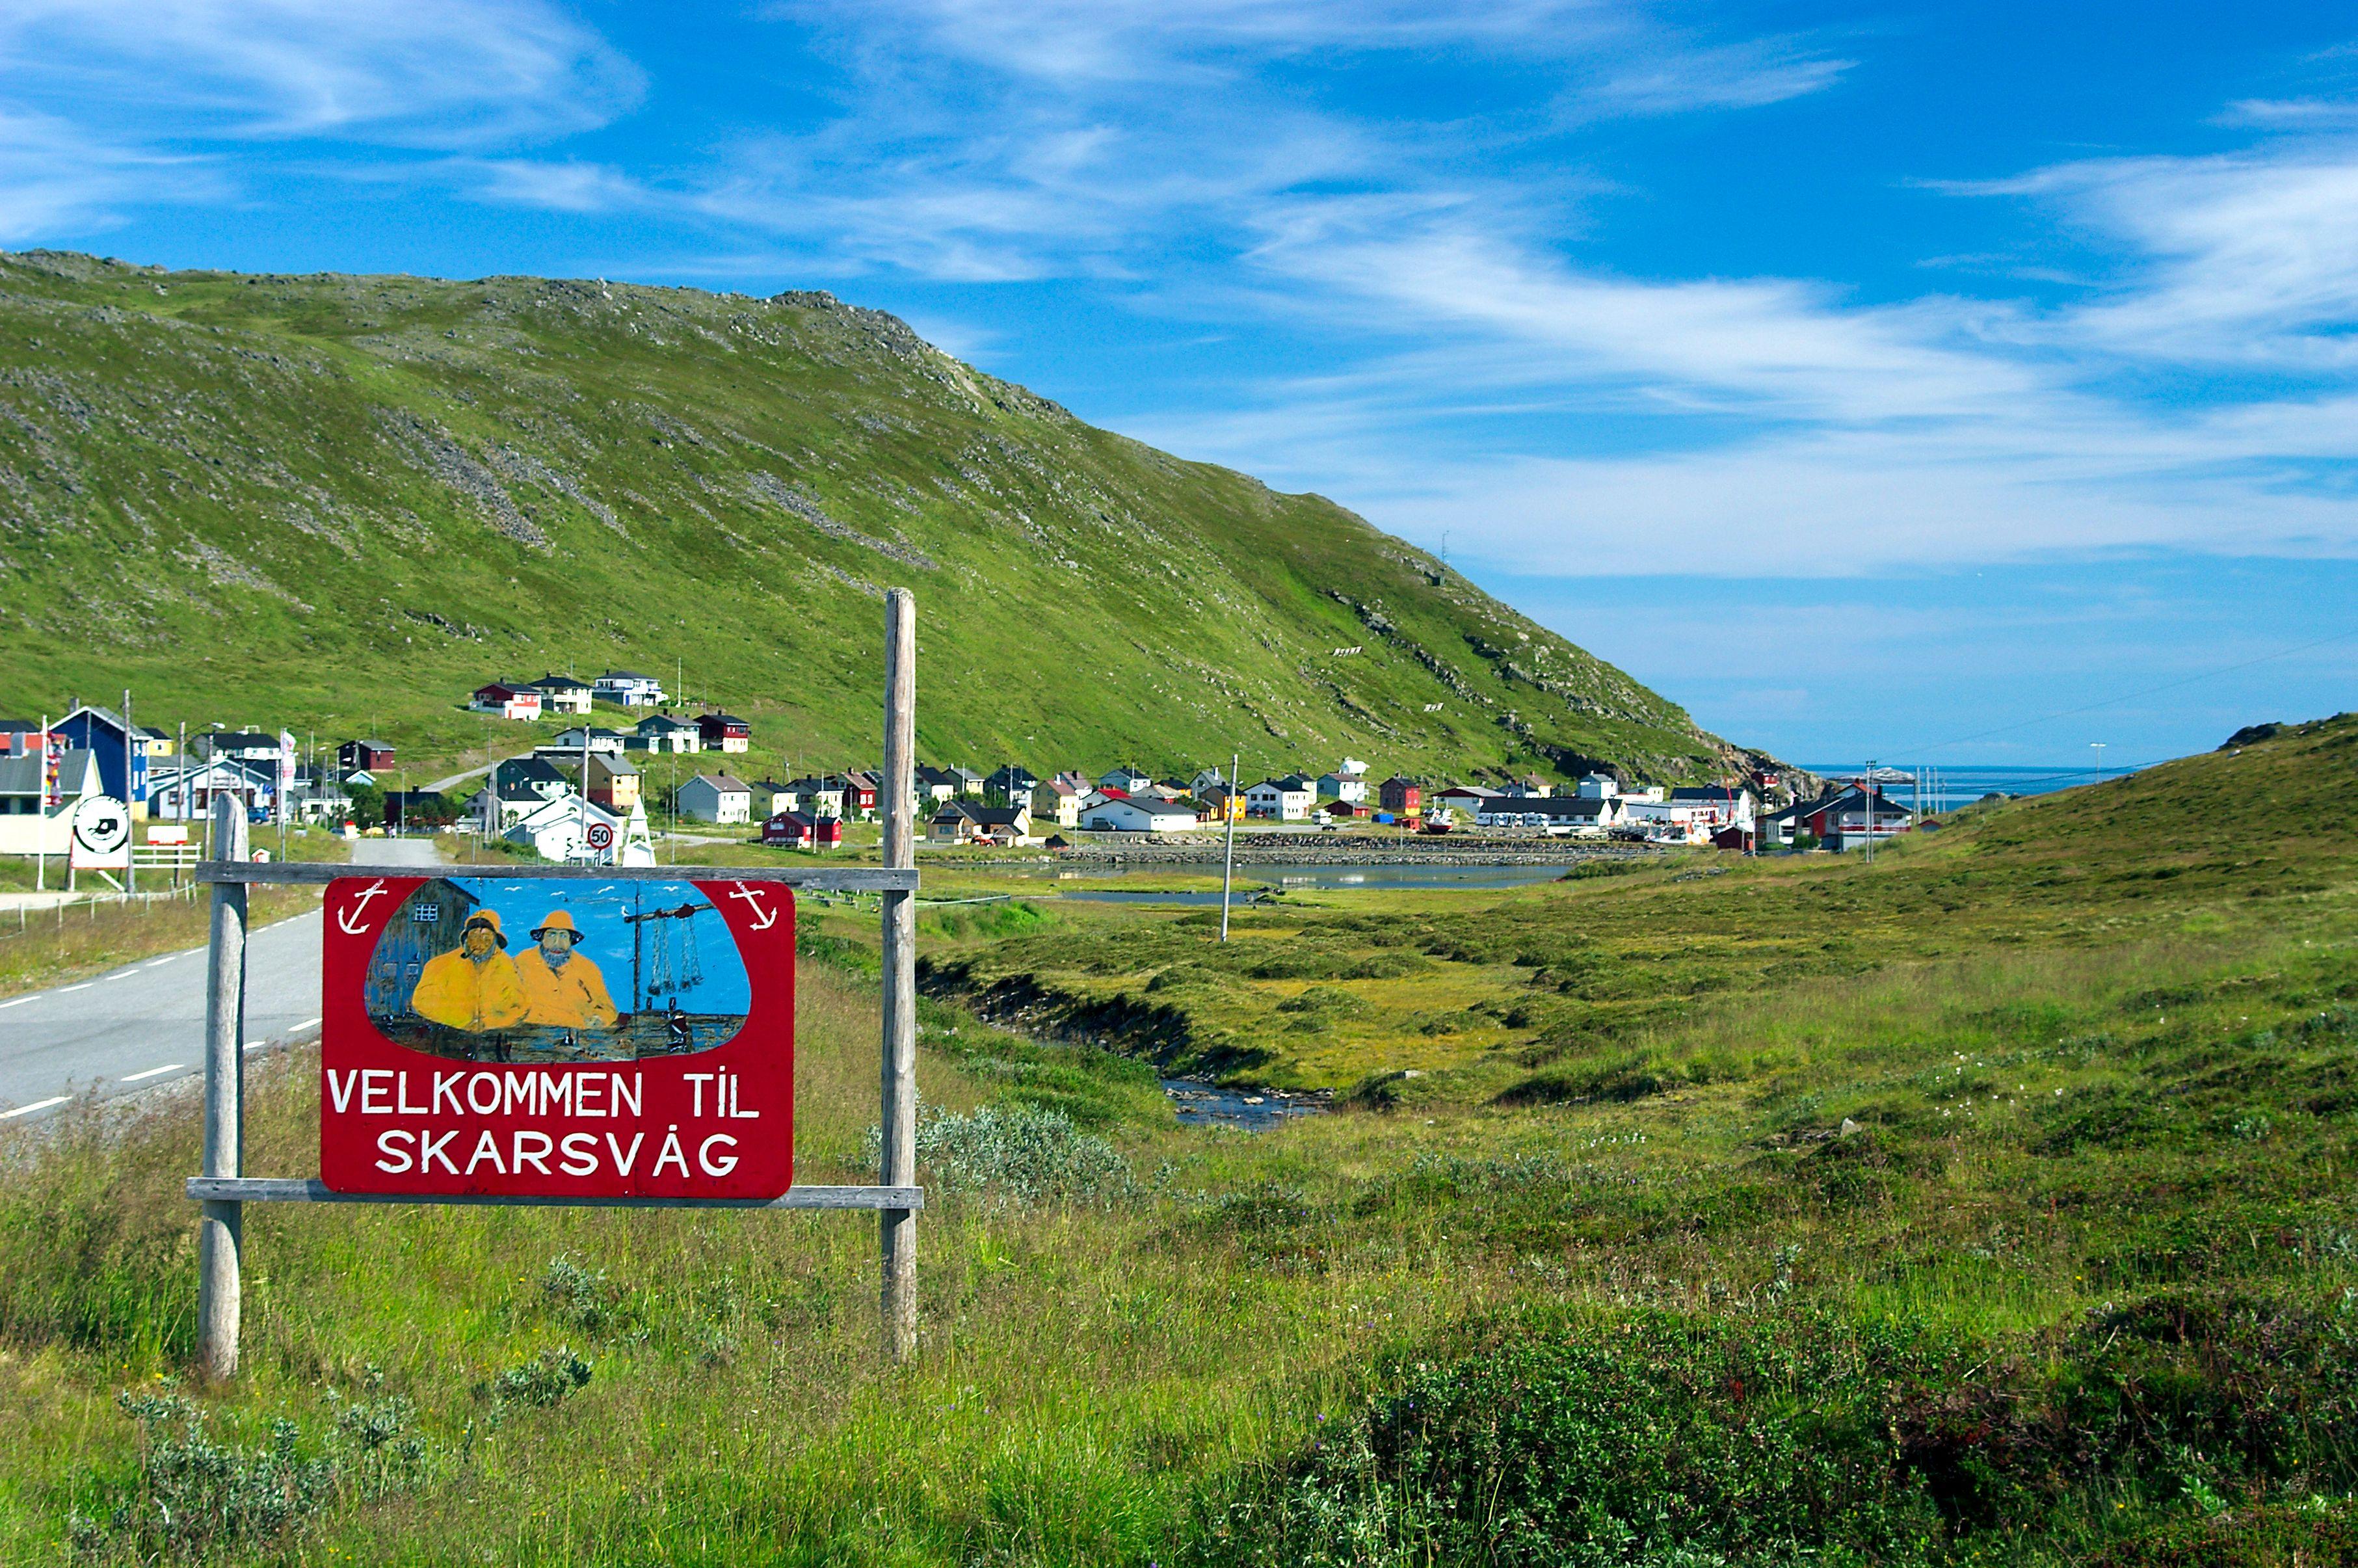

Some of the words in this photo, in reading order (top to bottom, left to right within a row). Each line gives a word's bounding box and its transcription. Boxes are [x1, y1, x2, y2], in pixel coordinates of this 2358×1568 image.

[592, 830, 609, 843] 50
[326, 1069, 642, 1117] VELKOMMEN
[375, 1124, 739, 1178] SKARSVÅG
